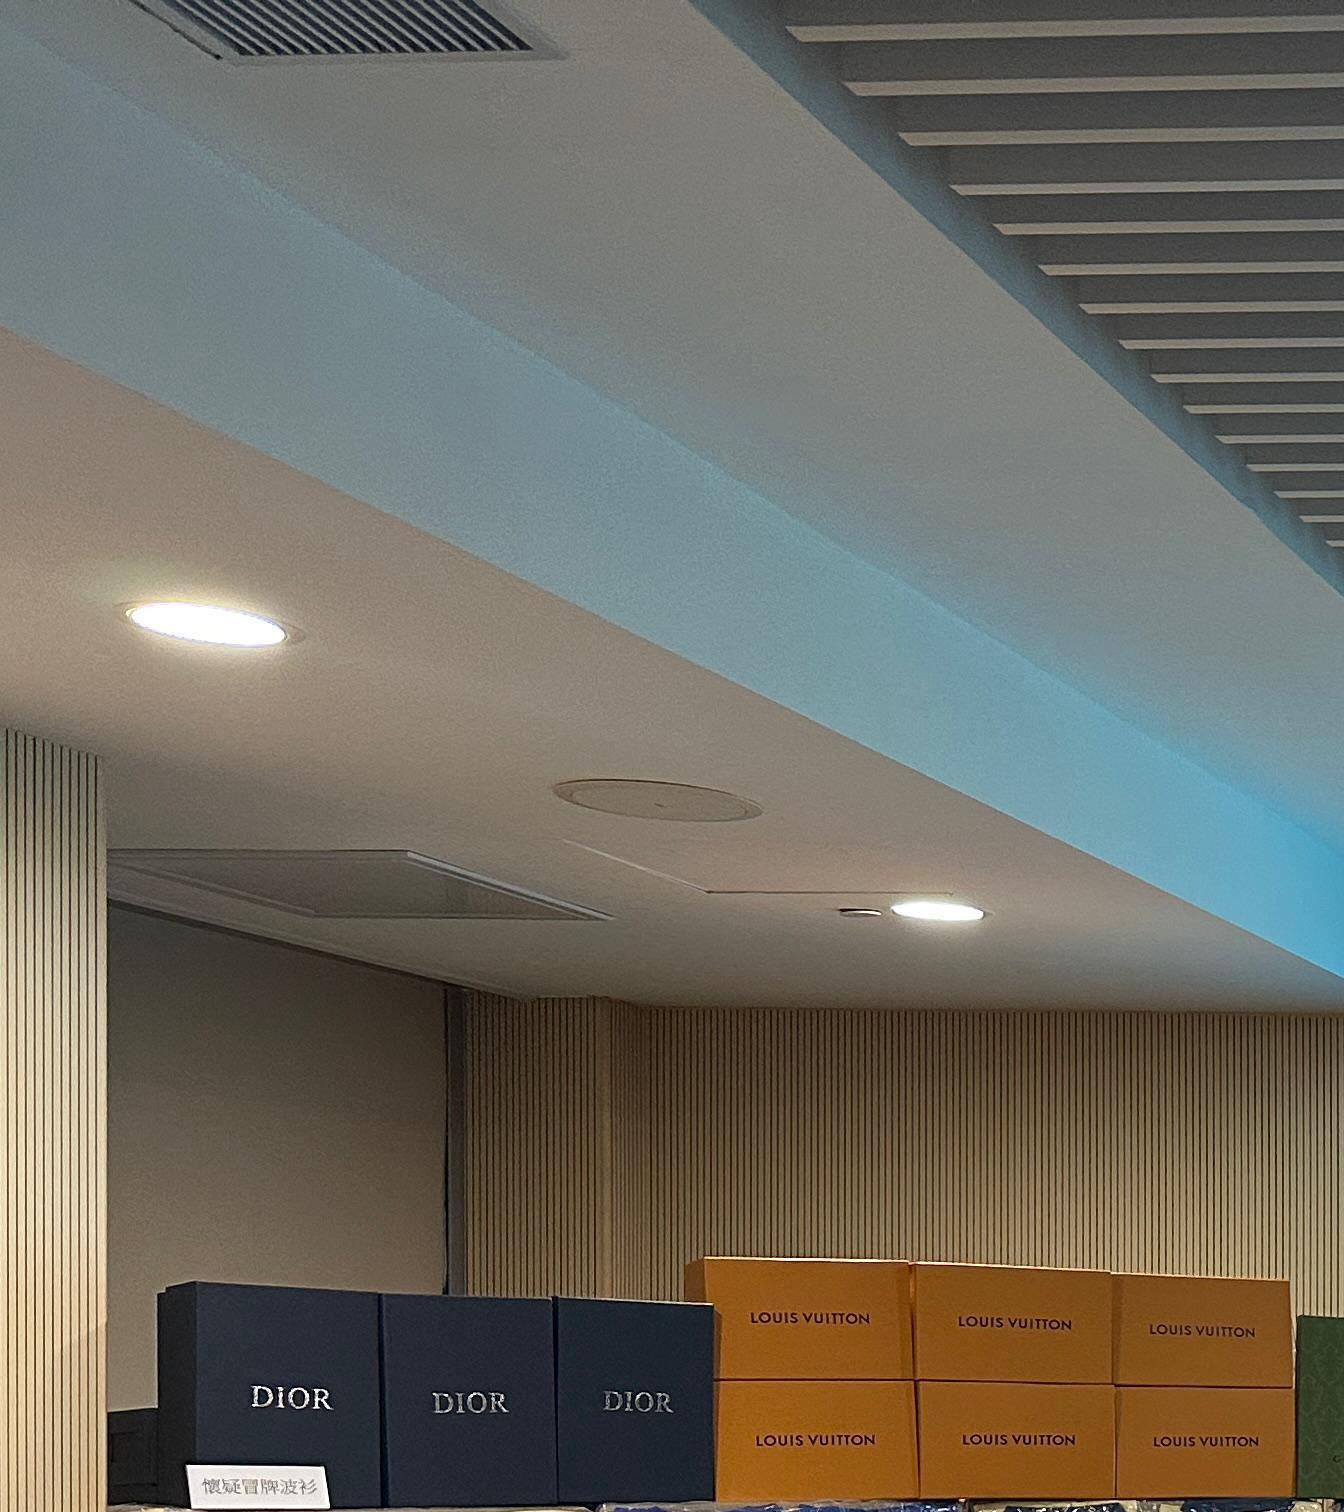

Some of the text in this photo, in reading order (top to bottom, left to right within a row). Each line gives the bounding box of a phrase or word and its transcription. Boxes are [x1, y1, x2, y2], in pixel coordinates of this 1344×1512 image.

[750, 1311, 870, 1325] LOUIS VUITTON
[958, 1315, 1072, 1331] LOUIS VUITTON
[1149, 1323, 1256, 1338] LOUIS VUITTON
[251, 1385, 334, 1411] DIOR
[432, 1391, 509, 1414] DIOR
[602, 1391, 674, 1414] DIOR
[756, 1433, 876, 1447] LOUIS VUITTON
[962, 1433, 1076, 1446] LOUIS VUITTON
[1153, 1436, 1259, 1448] LOUIS VUITTON
[201, 1477, 318, 1496] 懷疑冒牌波衫
